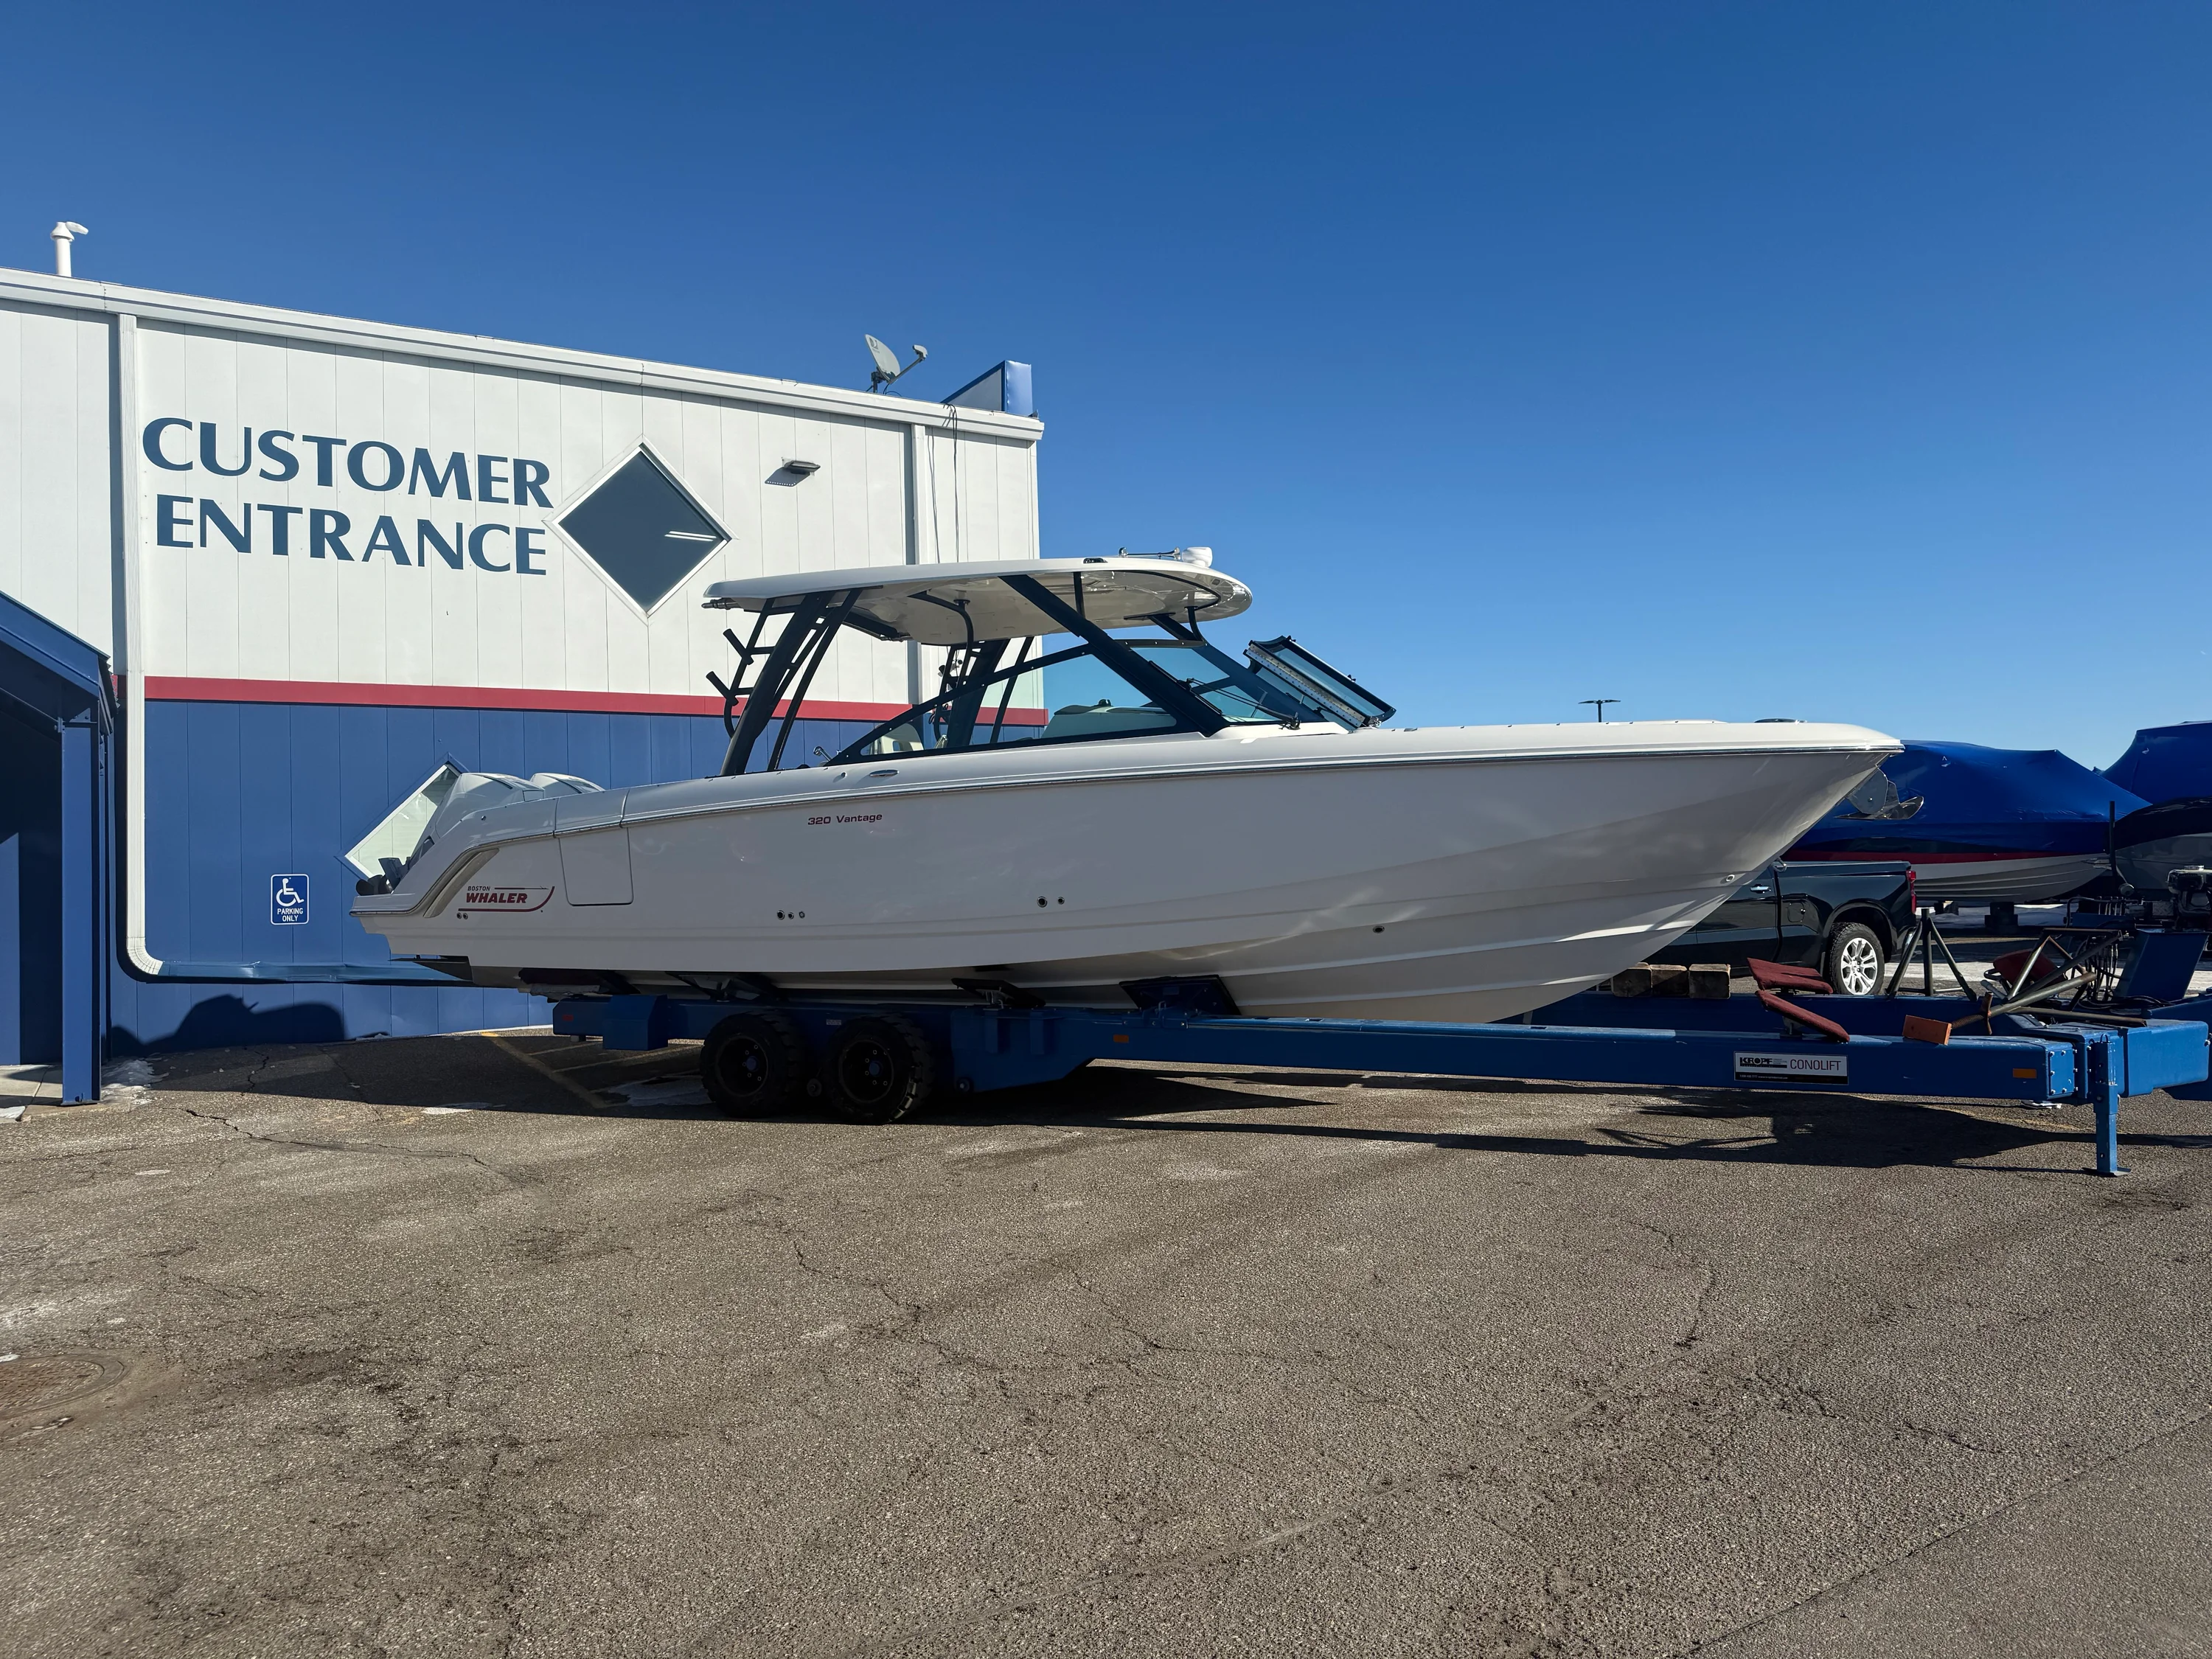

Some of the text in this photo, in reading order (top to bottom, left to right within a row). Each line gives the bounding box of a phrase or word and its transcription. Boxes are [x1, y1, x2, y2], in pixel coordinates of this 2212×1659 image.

[142, 417, 554, 509] CUSTOMER
[156, 493, 546, 576] ENTRANCE
[807, 814, 883, 825] 320 Vantage
[466, 892, 528, 903] WHALER
[1739, 1057, 1773, 1065] KROPF
[1790, 1059, 1842, 1071] CONOLIFT
